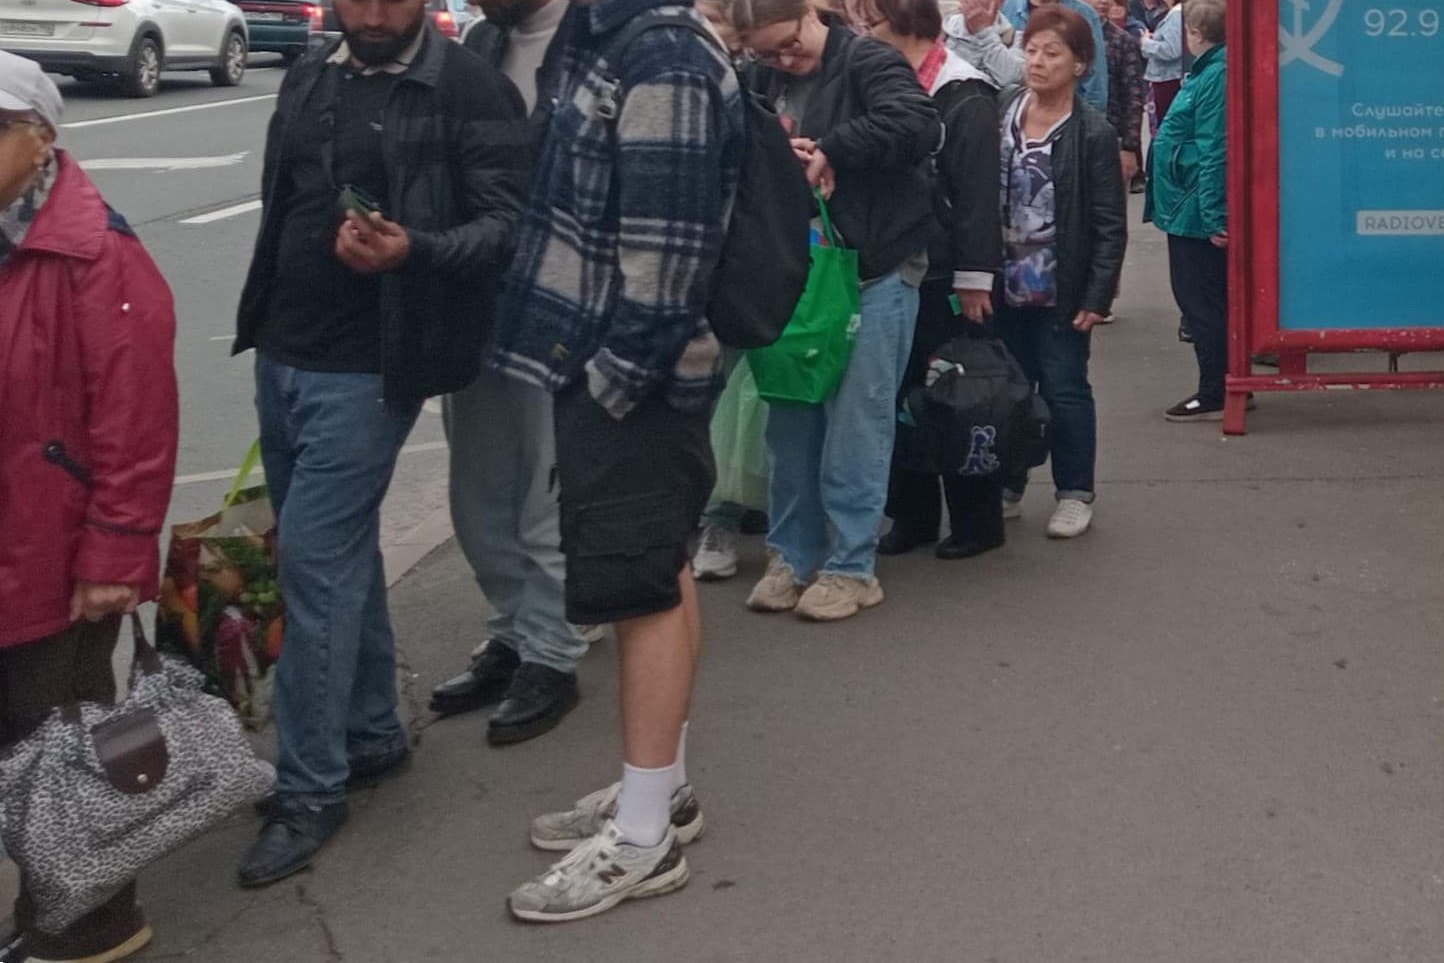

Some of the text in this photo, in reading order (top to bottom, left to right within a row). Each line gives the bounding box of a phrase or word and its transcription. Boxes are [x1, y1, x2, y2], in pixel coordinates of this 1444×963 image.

[1364, 9, 1440, 37] 92.9
[1315, 128, 1325, 138] в
[1331, 125, 1433, 138] мобильном
[1385, 149, 1397, 159] и
[1402, 148, 1425, 159] на
